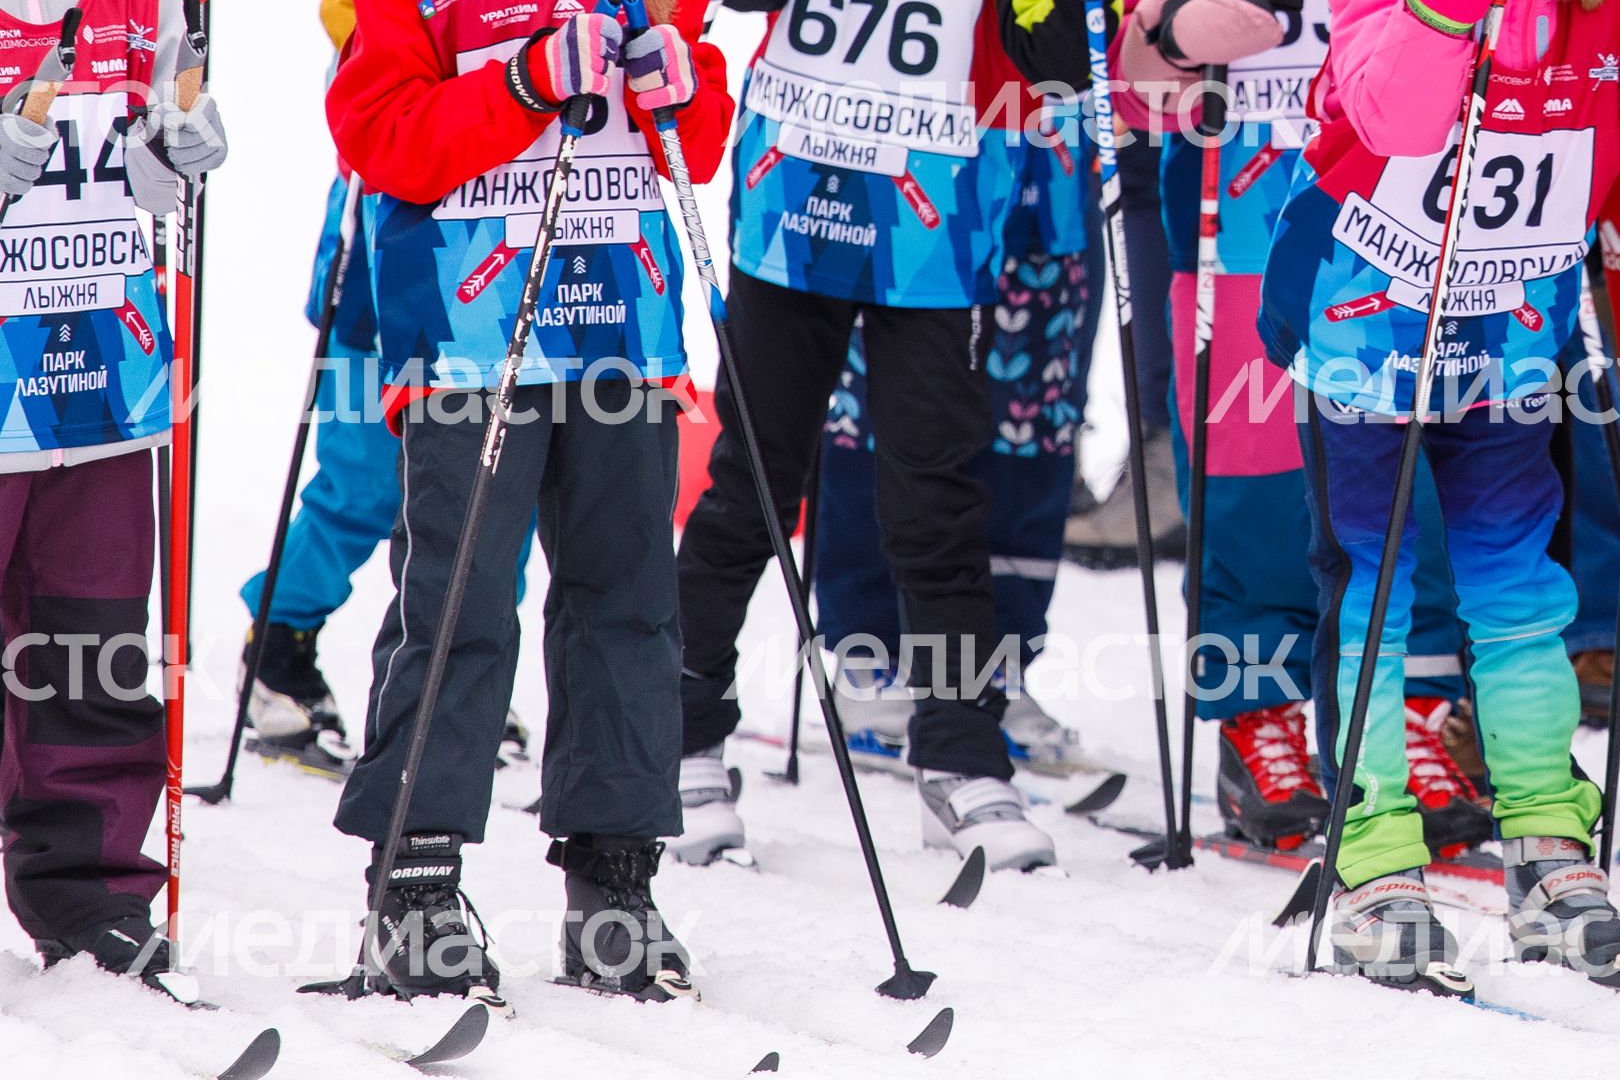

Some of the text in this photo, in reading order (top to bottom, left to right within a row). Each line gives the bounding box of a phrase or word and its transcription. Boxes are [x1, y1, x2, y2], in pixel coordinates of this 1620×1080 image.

[480, 3, 539, 23] УРАЛХИМ
[751, 68, 973, 147] МАНЖОСОВСКАЯ
[1088, 47, 1120, 167] NORDWAY
[799, 134, 878, 167] ЛЫЖНЯ
[1422, 143, 1554, 230] 631
[806, 196, 854, 222] ПАРК
[550, 216, 615, 240] ЫЖНЯ
[781, 210, 878, 247] ЛАЗУТИНОЙ
[23, 282, 99, 310] ЛЫЖНЯ
[557, 283, 604, 304] ПАРК
[42, 349, 86, 373] ПАРК
[1384, 348, 1491, 377] ЛАЗТИНОЙ
[14, 364, 108, 398] ЛАЗУТИНОЙ
[388, 866, 455, 881] ORDWAY
